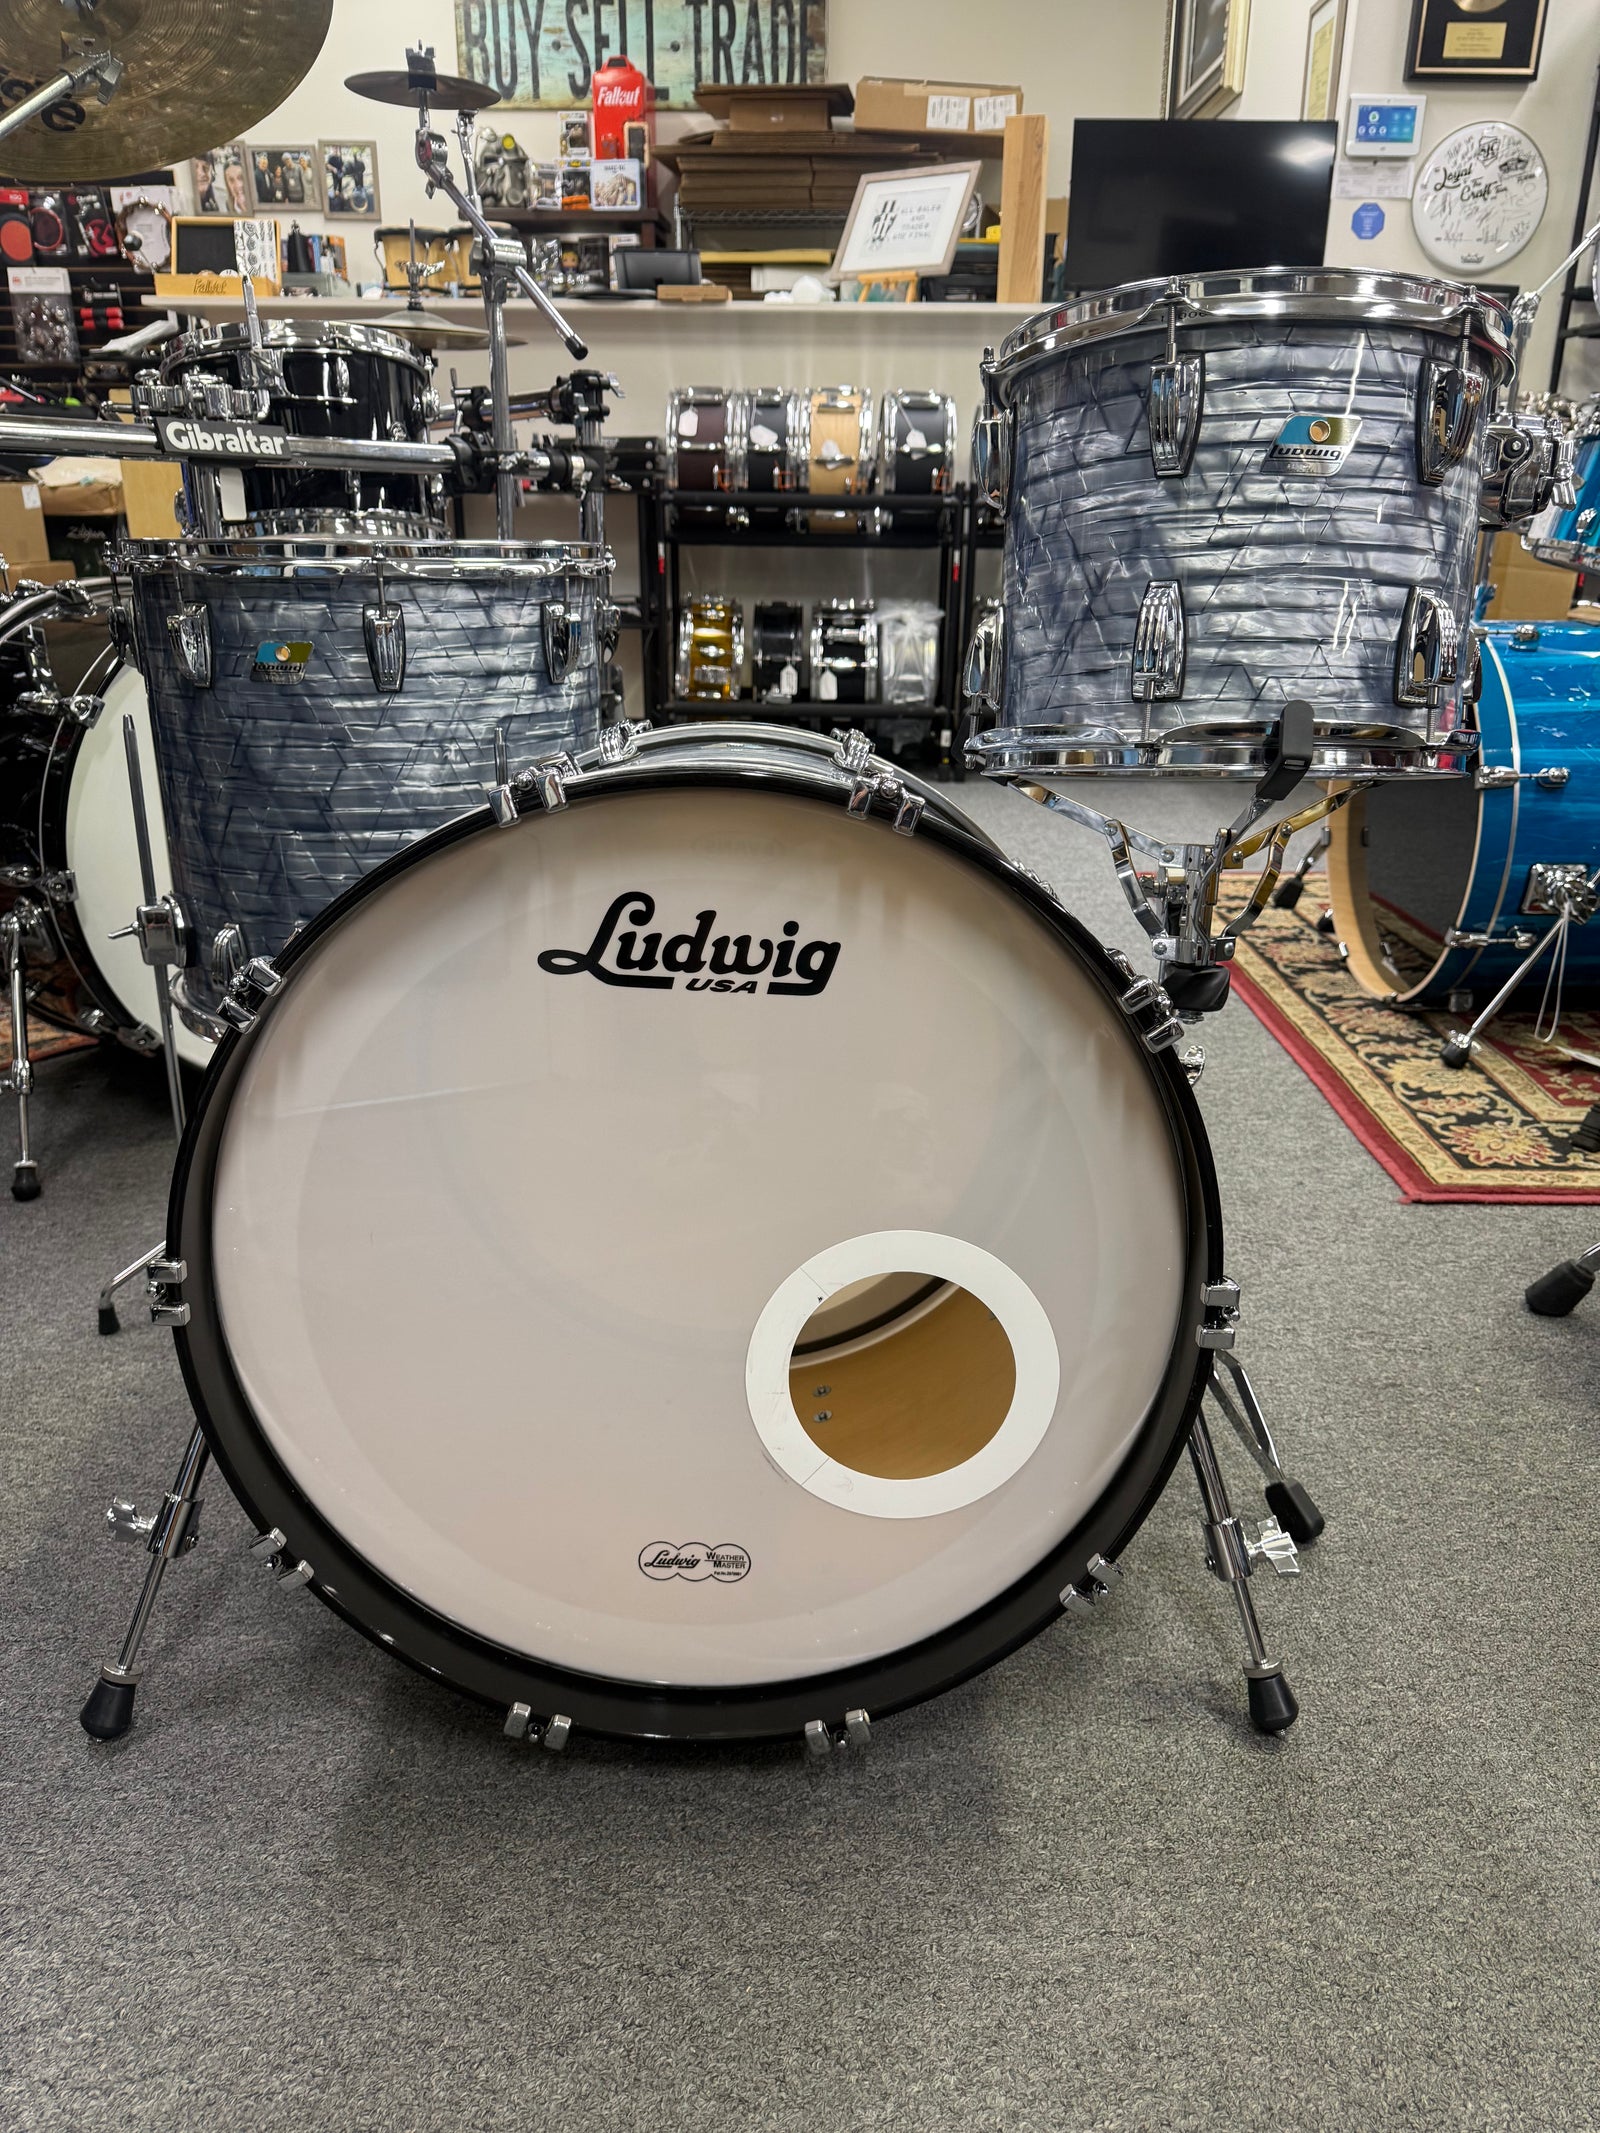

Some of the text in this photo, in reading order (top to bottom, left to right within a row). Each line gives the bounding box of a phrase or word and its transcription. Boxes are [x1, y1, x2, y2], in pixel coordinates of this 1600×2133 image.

[463, 0, 815, 100] BUY SELL TRADE
[597, 85, 641, 107] Fallout
[1460, 181, 1498, 201] Craft
[166, 421, 284, 456] Gibraltar
[537, 891, 841, 996] Ludwig
[685, 978, 757, 994] USA
[644, 1550, 701, 1569] Ludwig
